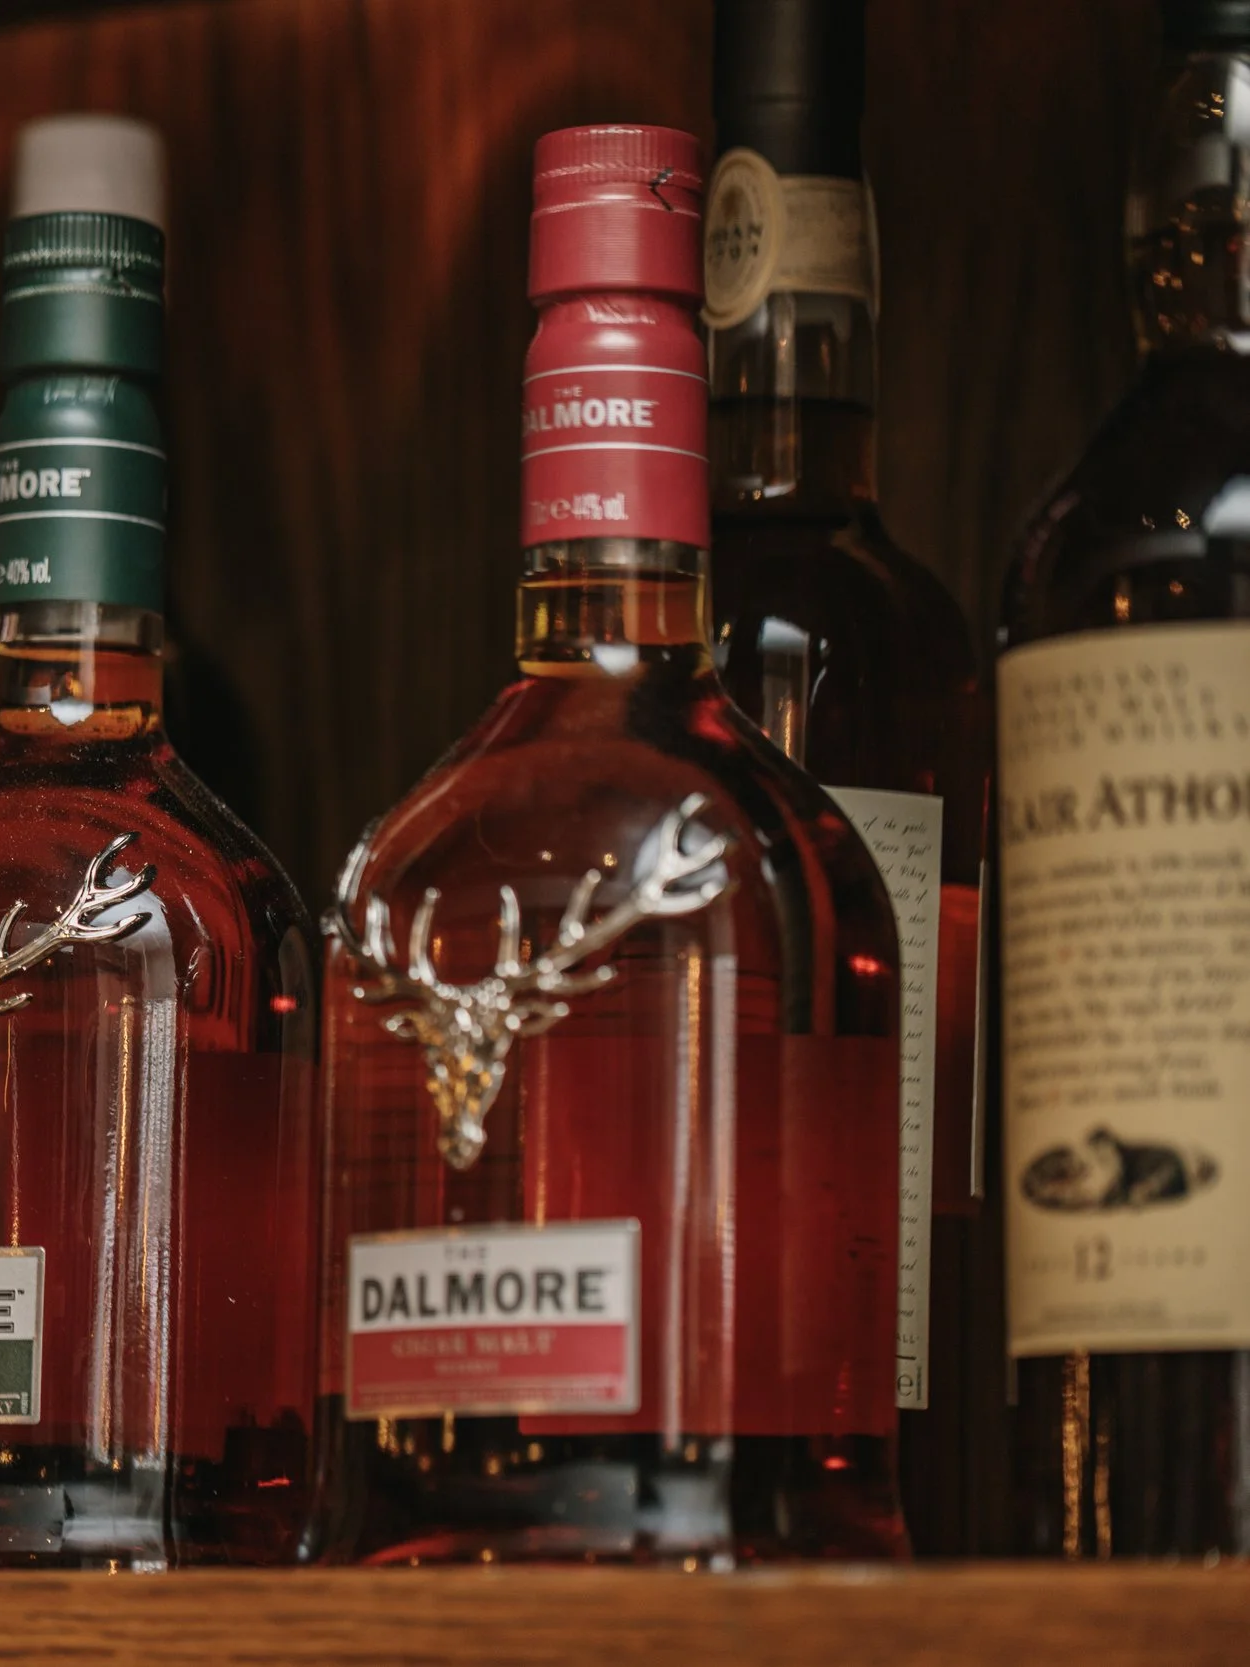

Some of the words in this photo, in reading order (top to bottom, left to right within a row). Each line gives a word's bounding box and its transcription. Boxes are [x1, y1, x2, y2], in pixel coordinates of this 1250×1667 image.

[554, 386, 583, 398] THE
[1086, 769, 1250, 830] ATHO
[360, 1269, 606, 1322] DALMORE
